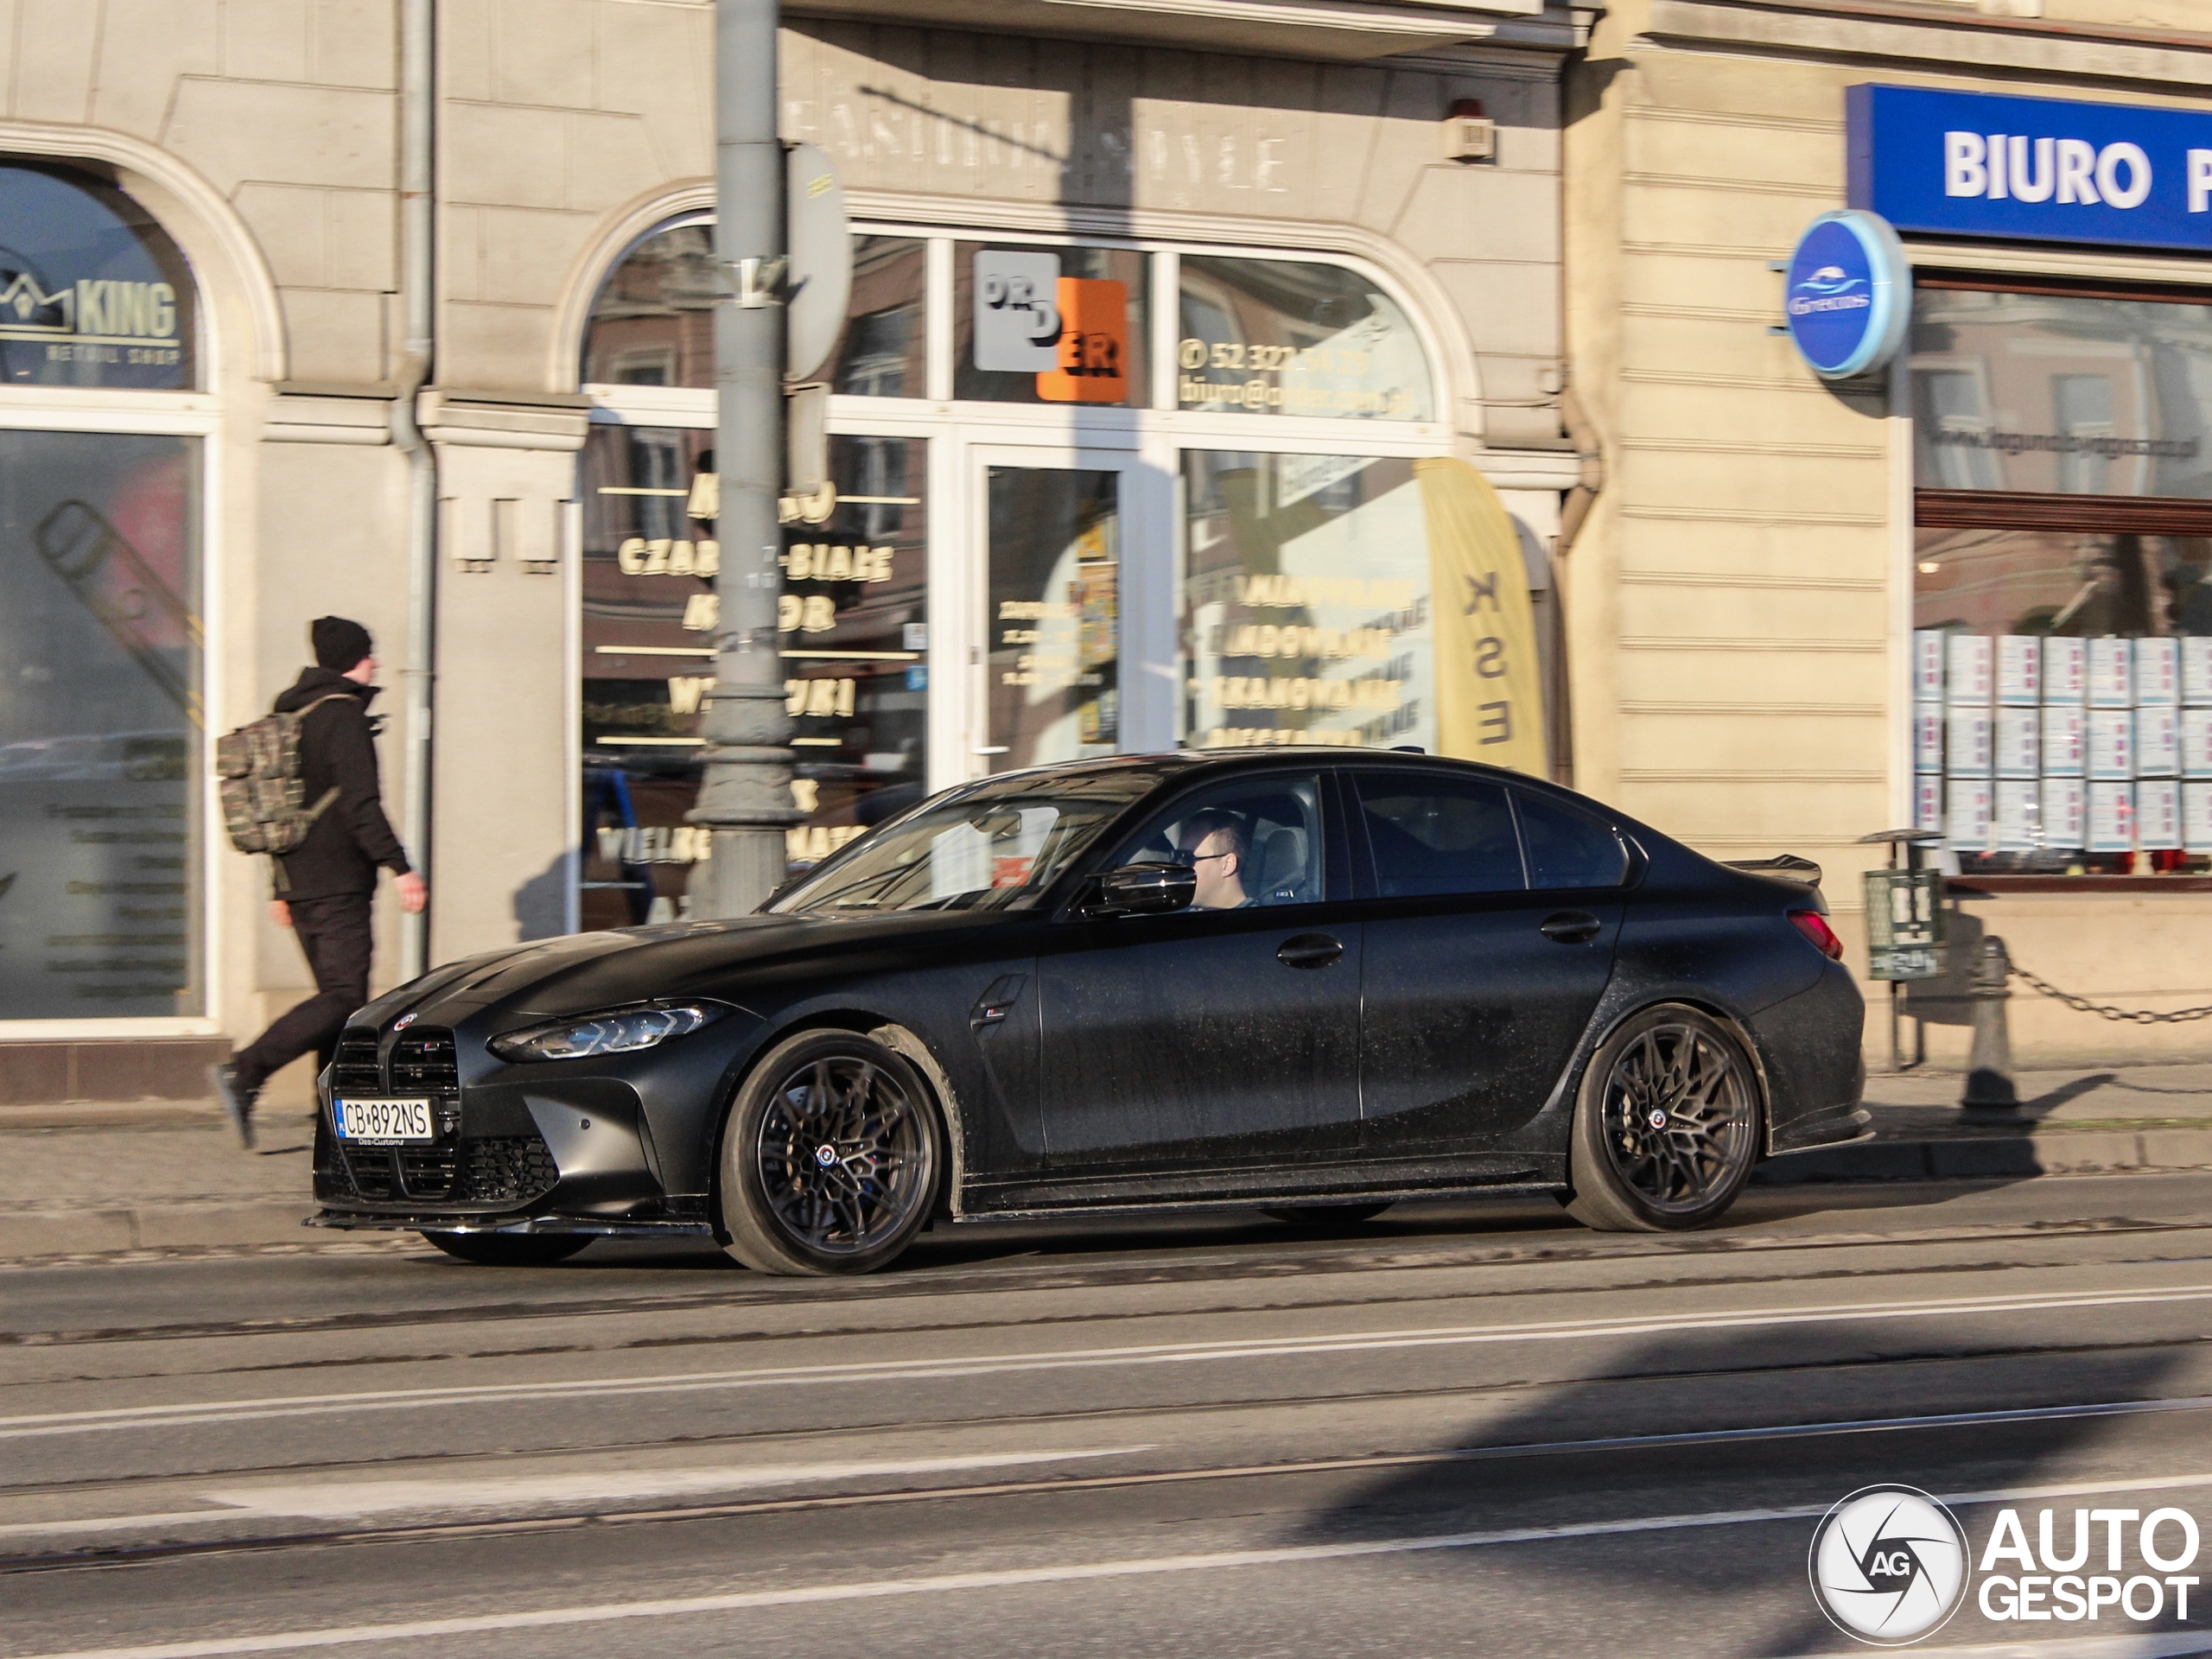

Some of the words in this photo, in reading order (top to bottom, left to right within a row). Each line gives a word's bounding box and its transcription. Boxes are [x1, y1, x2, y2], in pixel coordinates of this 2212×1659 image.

[1944, 130, 2153, 209] BIURO
[76, 279, 175, 338] KING
[1211, 343, 1245, 369] 52
[346, 1103, 366, 1135] CB
[371, 1103, 426, 1135] 892NS
